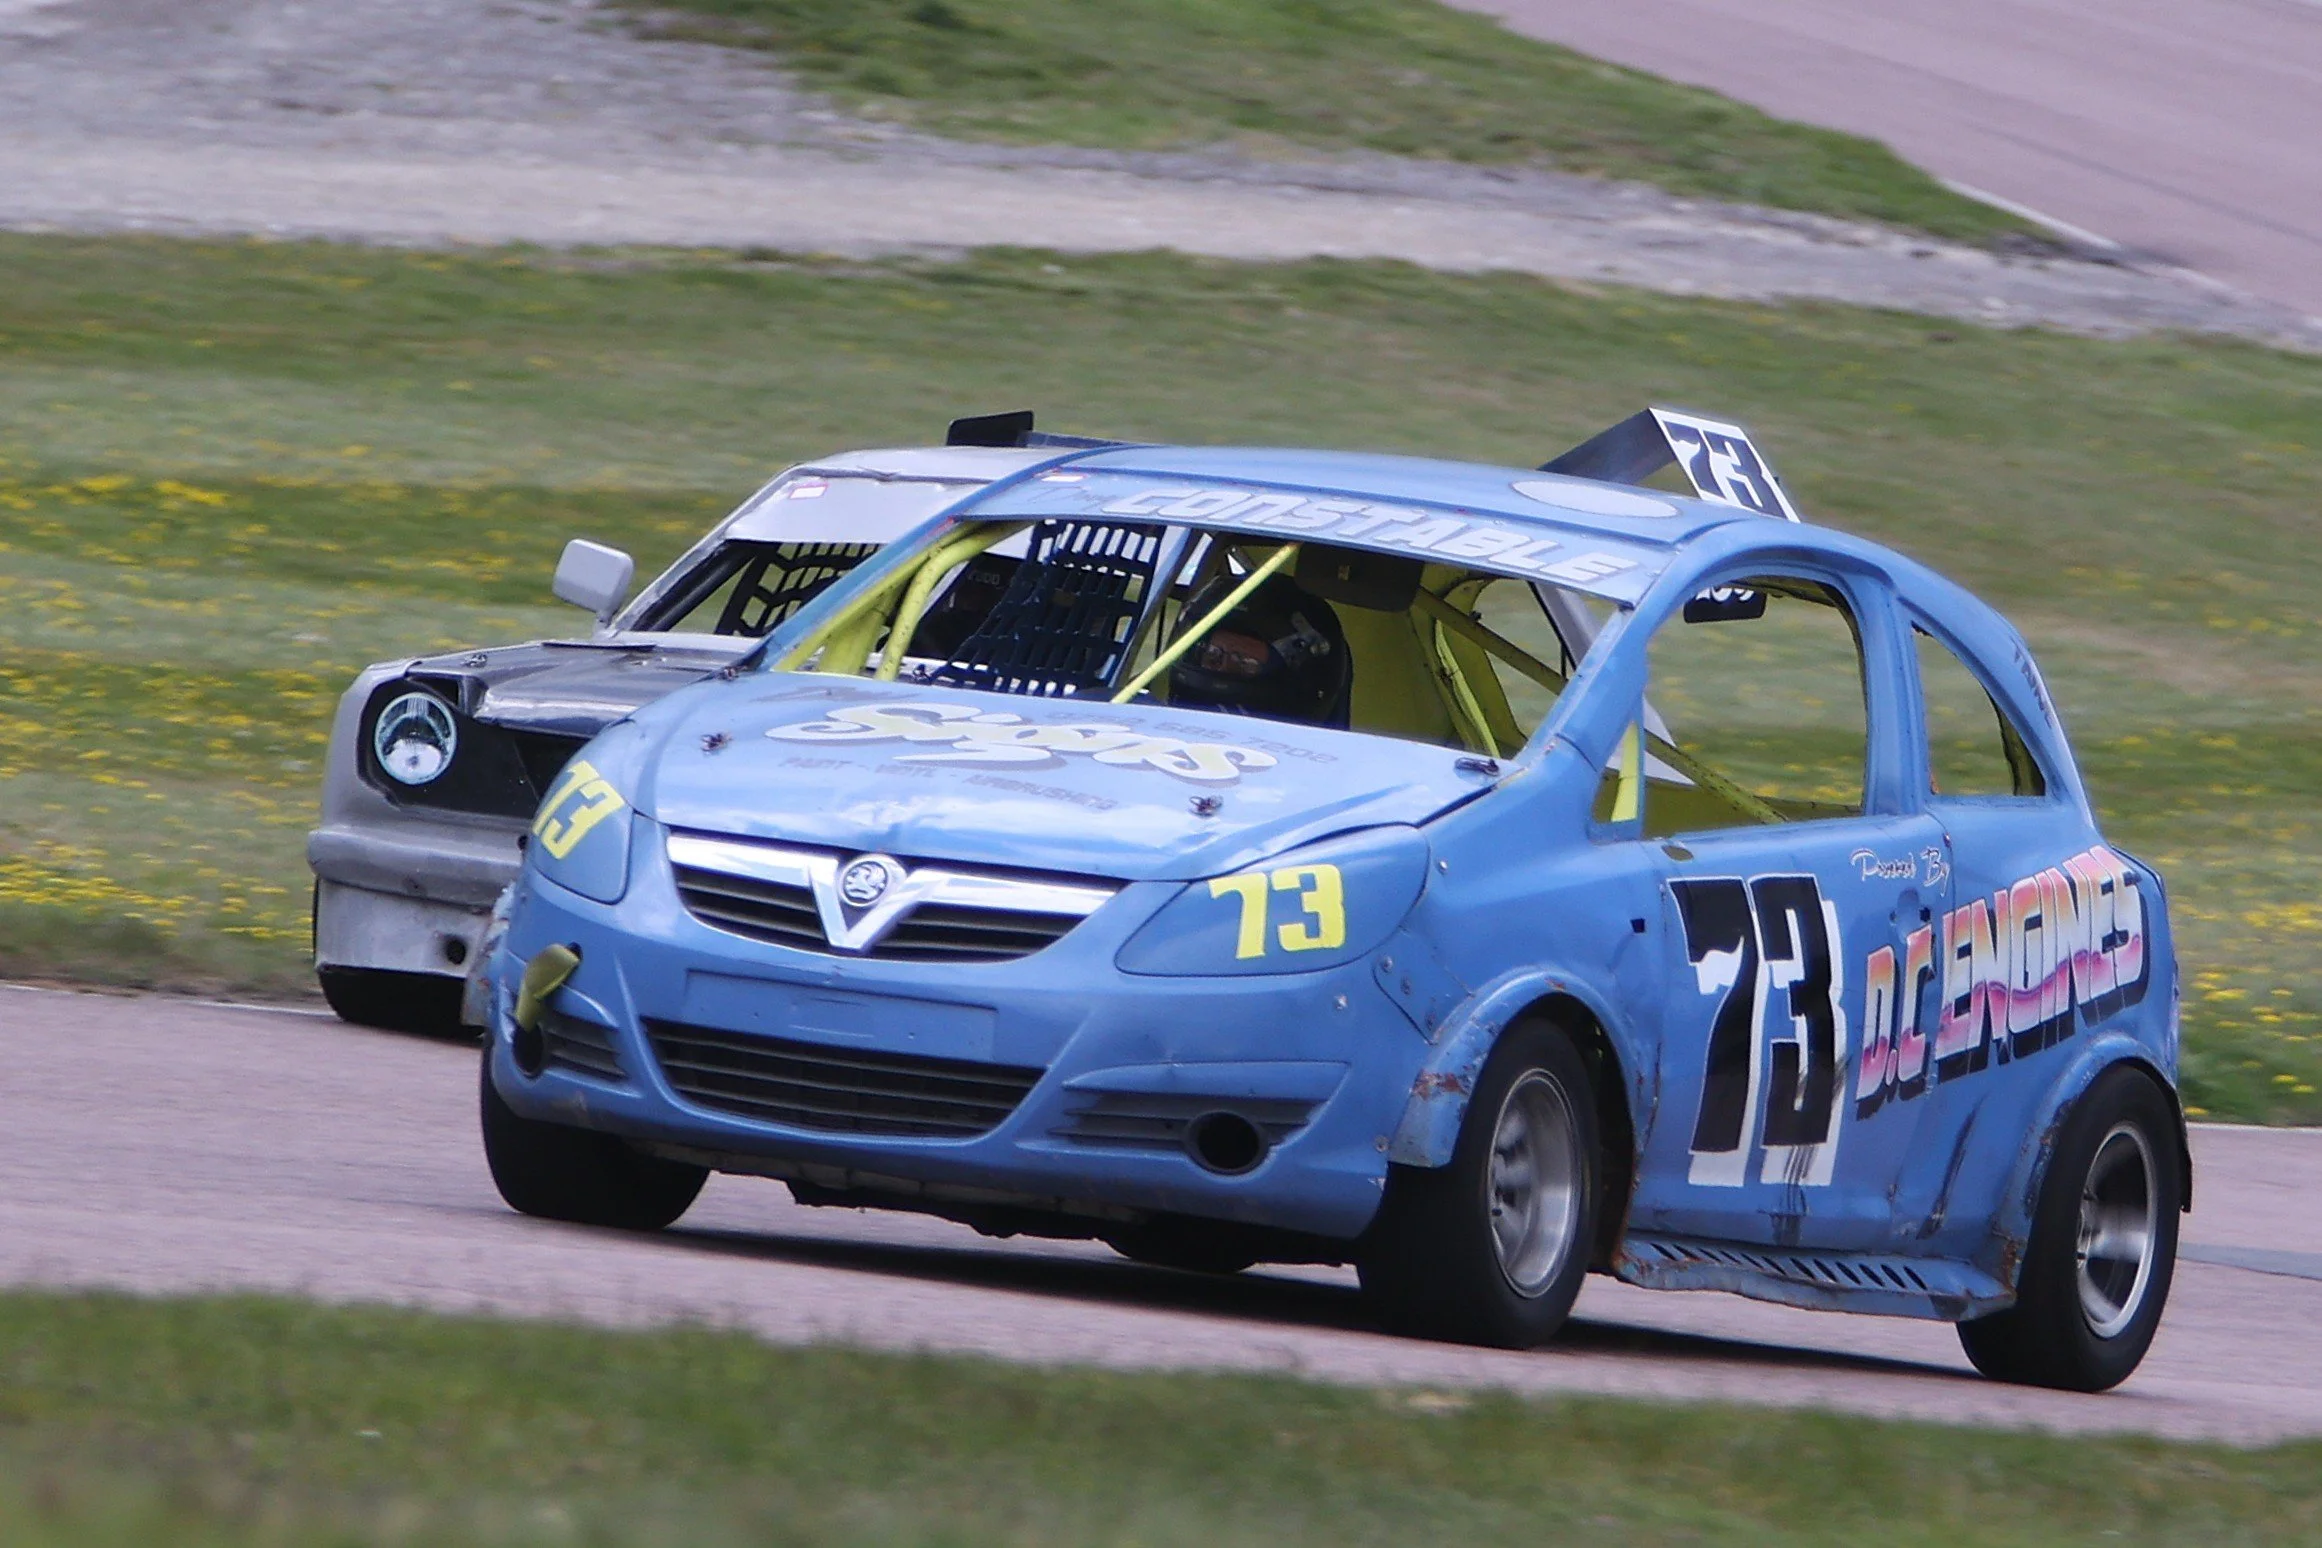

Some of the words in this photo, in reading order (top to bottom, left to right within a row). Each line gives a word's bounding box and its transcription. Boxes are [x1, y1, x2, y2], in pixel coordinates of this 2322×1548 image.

[1662, 420, 1790, 520] 73
[1101, 487, 1641, 585] CONSTABLE
[532, 760, 625, 860] 73
[1208, 863, 1346, 960] 73
[1935, 845, 2148, 1075] ENGINES
[1667, 873, 1847, 1187] 73
